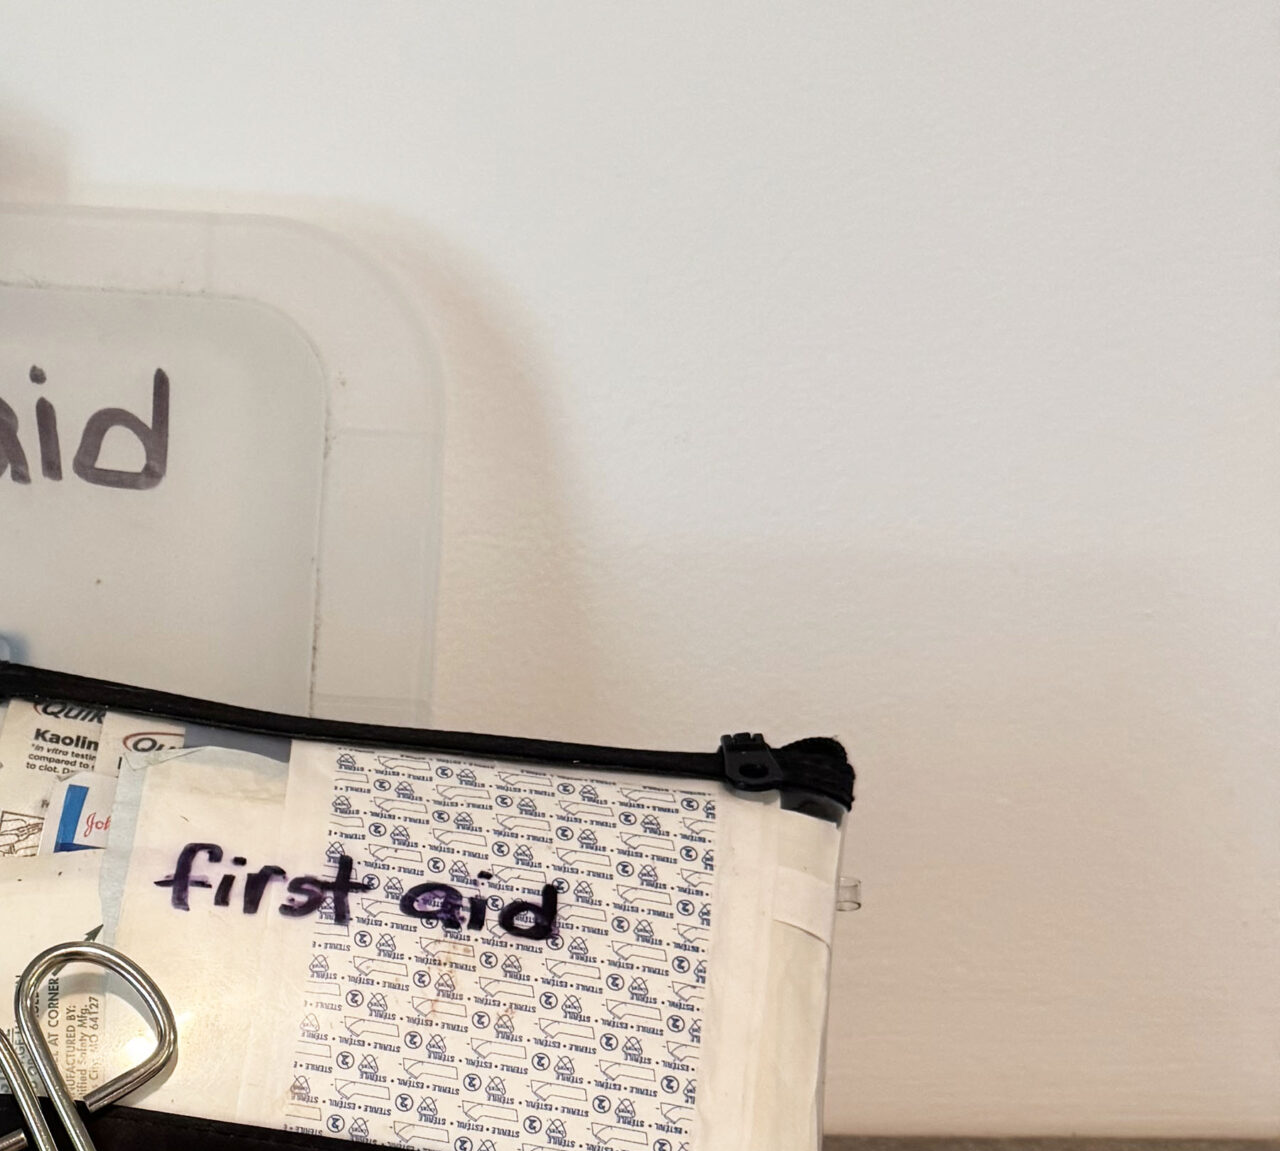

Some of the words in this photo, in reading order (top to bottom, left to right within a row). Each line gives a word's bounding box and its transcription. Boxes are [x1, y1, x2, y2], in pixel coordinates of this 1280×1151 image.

[33, 727, 100, 752] Kaolin
[46, 745, 70, 757] vitro
[25, 761, 37, 771] to
[27, 752, 78, 768] compared
[79, 760, 90, 770] to
[153, 842, 373, 926] first
[398, 869, 559, 941] aid
[47, 977, 60, 1028] CORNER
[65, 1004, 77, 1022] BY:
[88, 995, 99, 1031] 64127
[79, 1003, 90, 1029] Mfg.
[48, 1032, 60, 1047] AT
[65, 1024, 77, 1099] NUFACTURED
